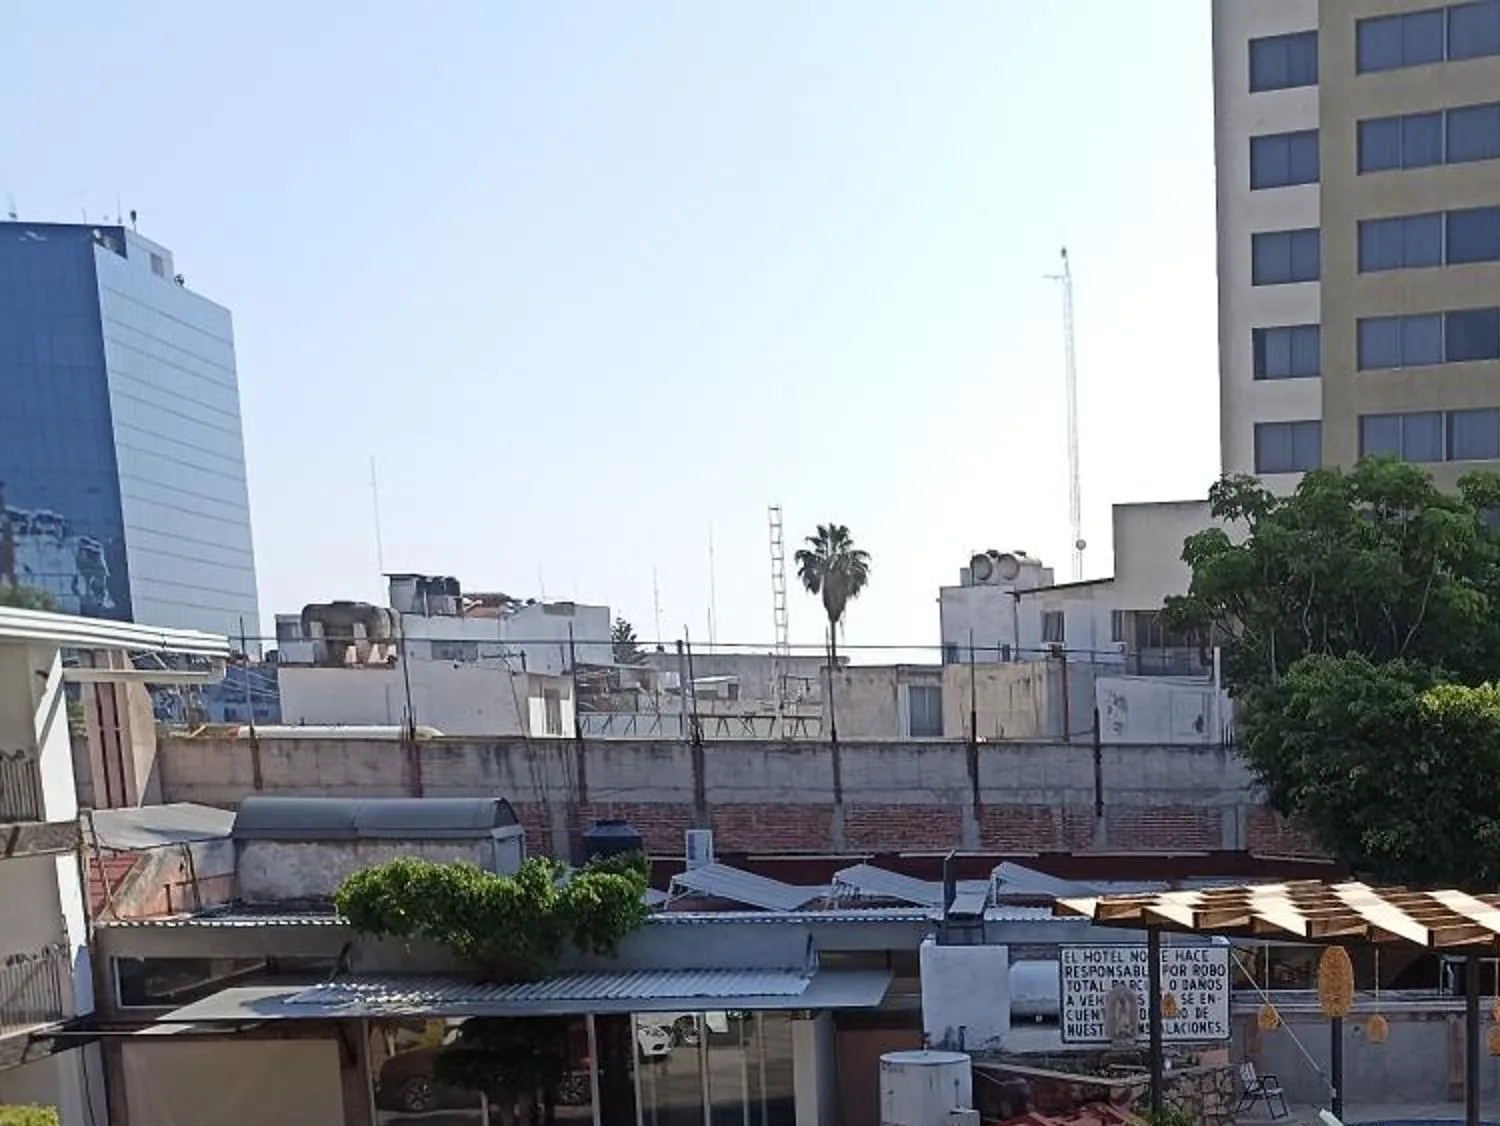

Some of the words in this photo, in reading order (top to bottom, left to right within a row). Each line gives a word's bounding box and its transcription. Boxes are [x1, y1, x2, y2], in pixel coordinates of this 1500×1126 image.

[1063, 951, 1076, 963] EL
[1083, 951, 1123, 963] HOTEL
[1130, 950, 1147, 962] NO
[1175, 950, 1208, 962] HACE
[1065, 965, 1148, 978] RESPONSABL
[1192, 964, 1226, 977] ROBO
[1066, 980, 1105, 992] TOTAL
[1169, 979, 1177, 991] O
[1066, 996, 1075, 1006] A
[1181, 992, 1194, 1005] SE
[1195, 1007, 1209, 1019] DE
